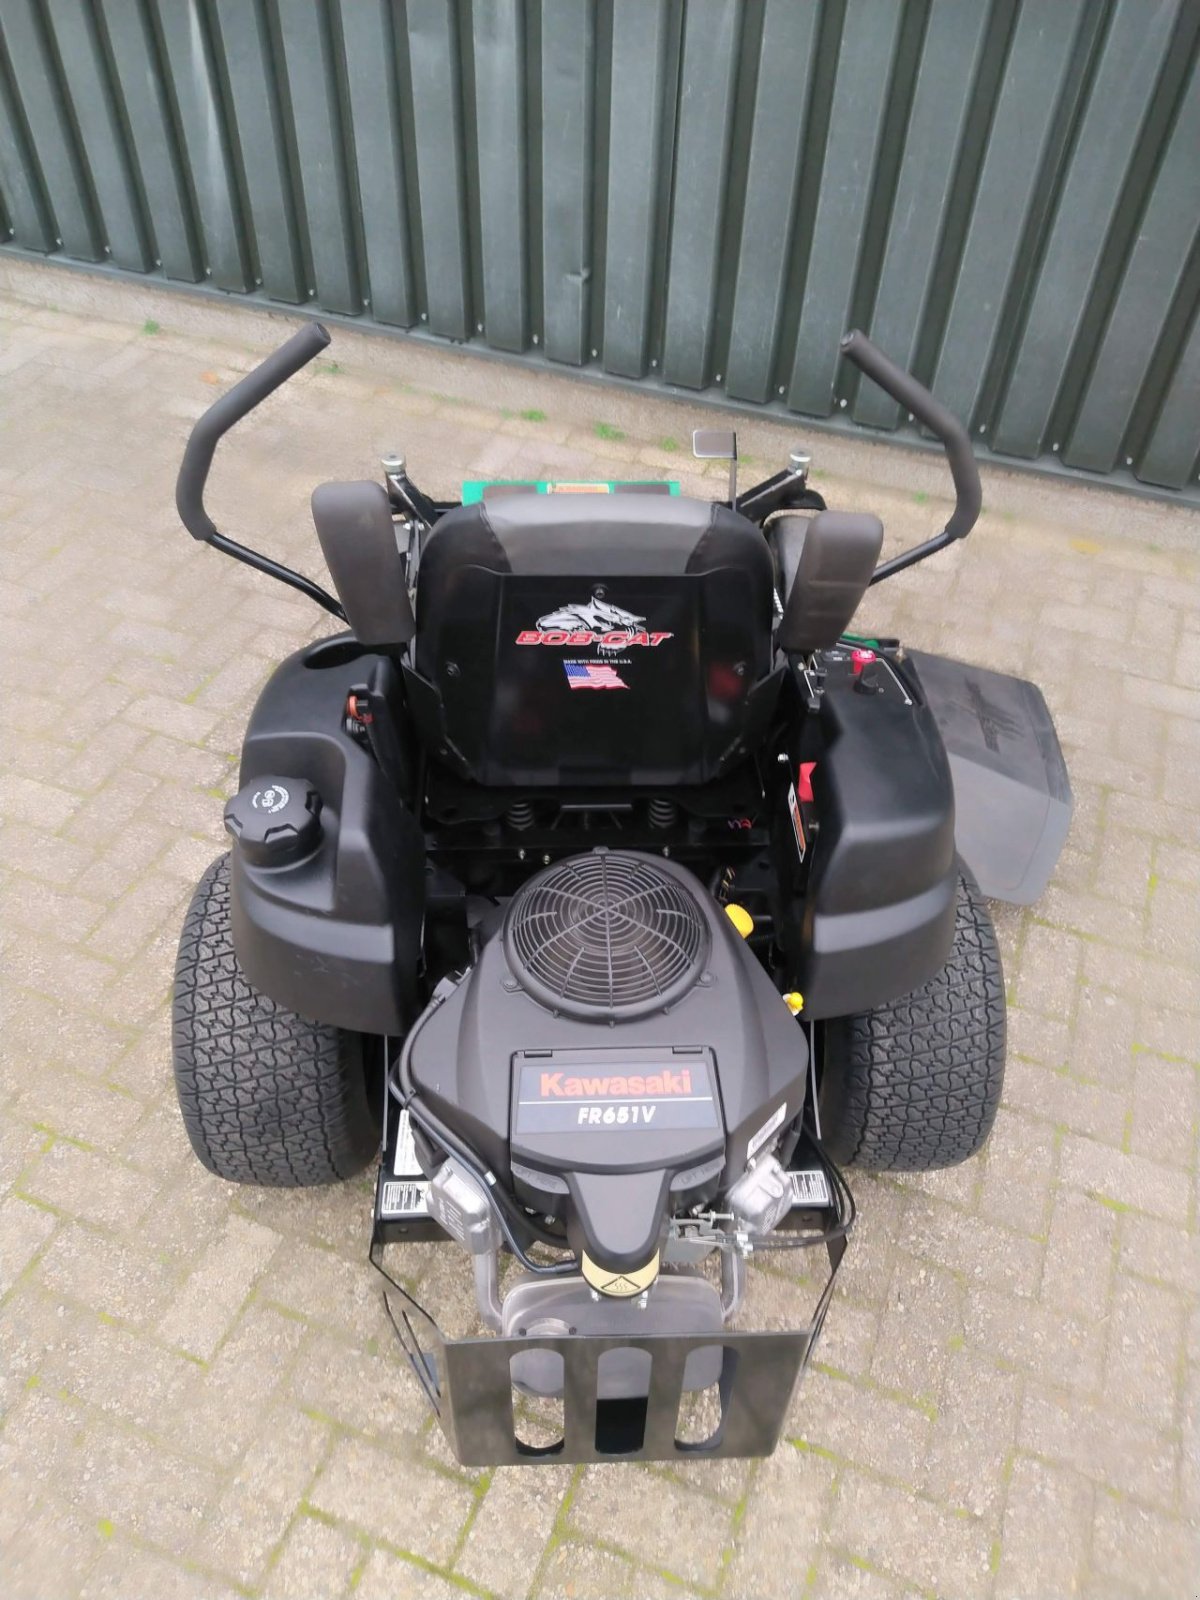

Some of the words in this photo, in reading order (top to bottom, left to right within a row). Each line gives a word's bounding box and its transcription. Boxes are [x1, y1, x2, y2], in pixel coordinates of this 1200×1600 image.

[515, 630, 672, 647] BOB-CAT
[540, 1070, 692, 1097] Kawasaki
[577, 1105, 656, 1125] FR651V
